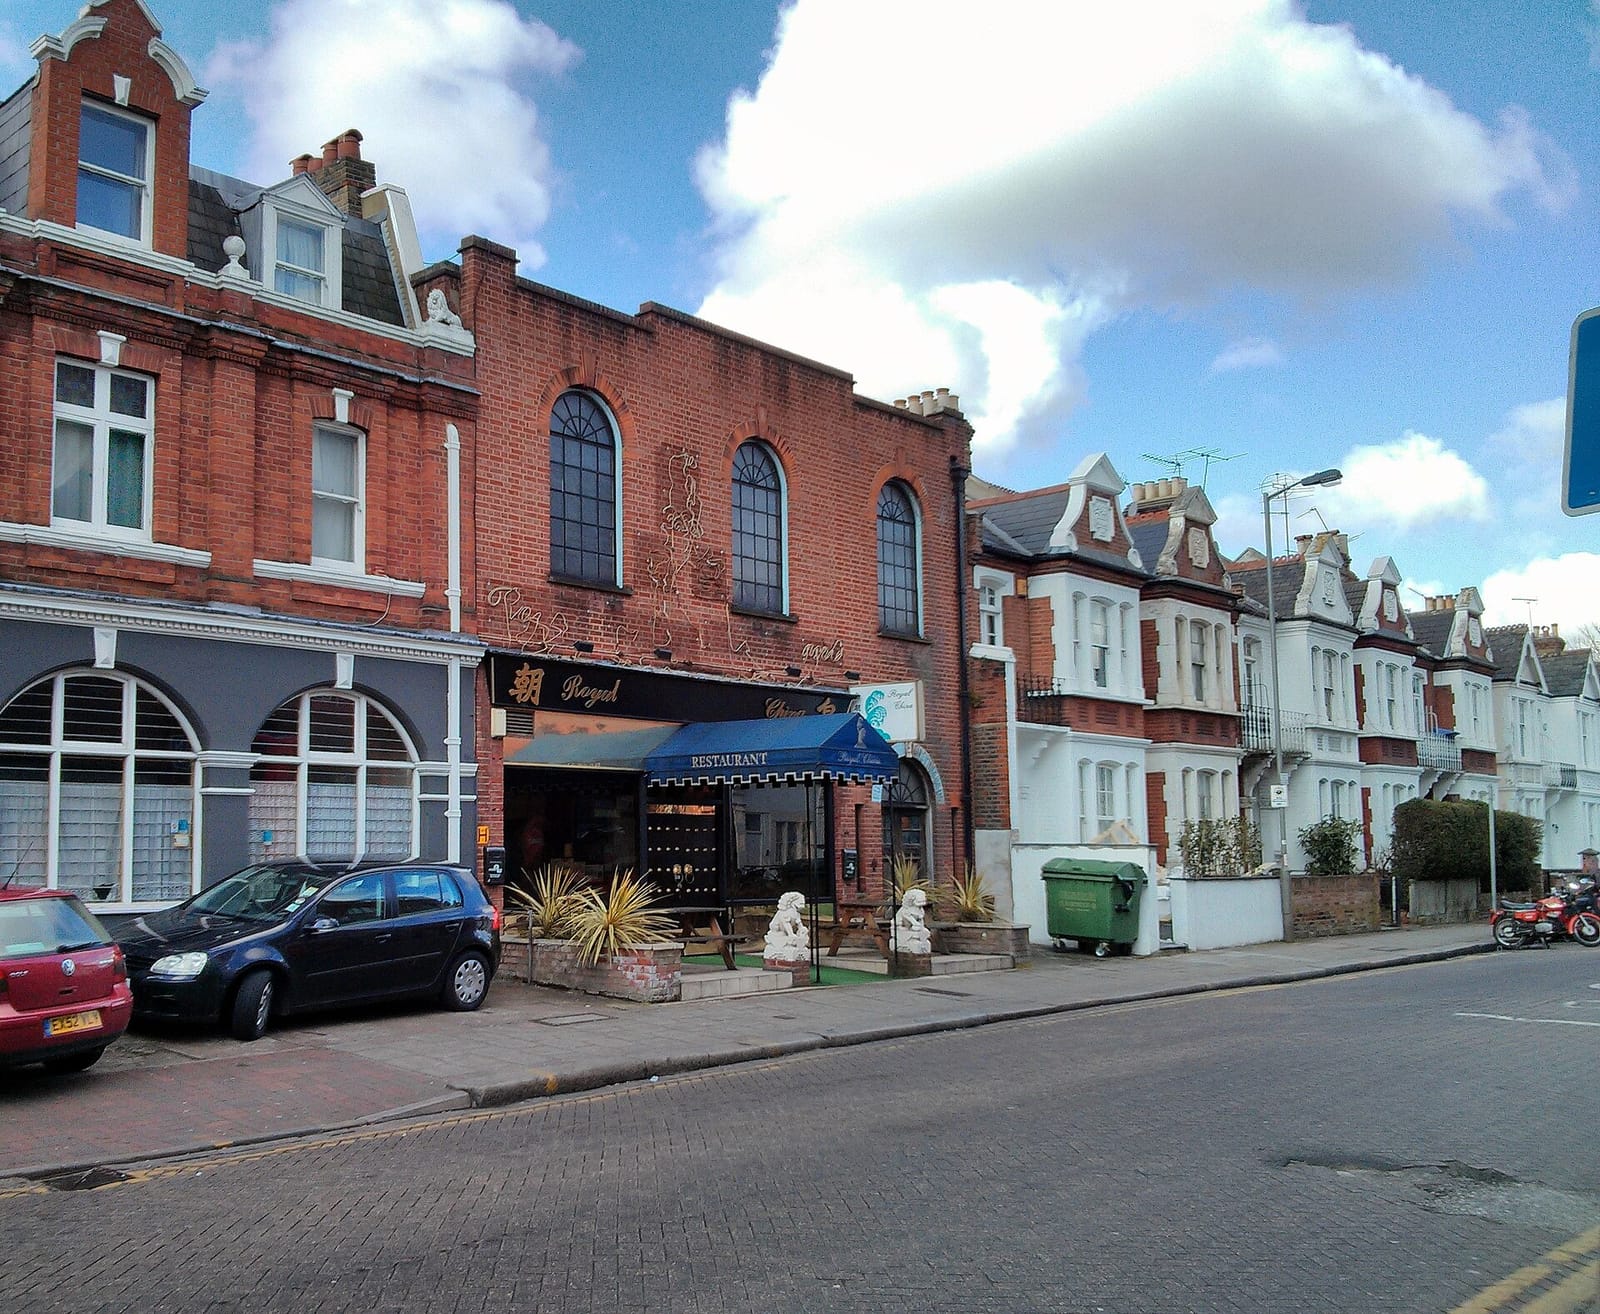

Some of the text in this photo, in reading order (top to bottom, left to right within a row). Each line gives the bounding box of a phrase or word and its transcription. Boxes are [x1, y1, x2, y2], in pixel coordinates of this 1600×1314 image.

[508, 662, 545, 706] 朝
[561, 674, 622, 709] Royal
[691, 751, 768, 768] RESTAURANT
